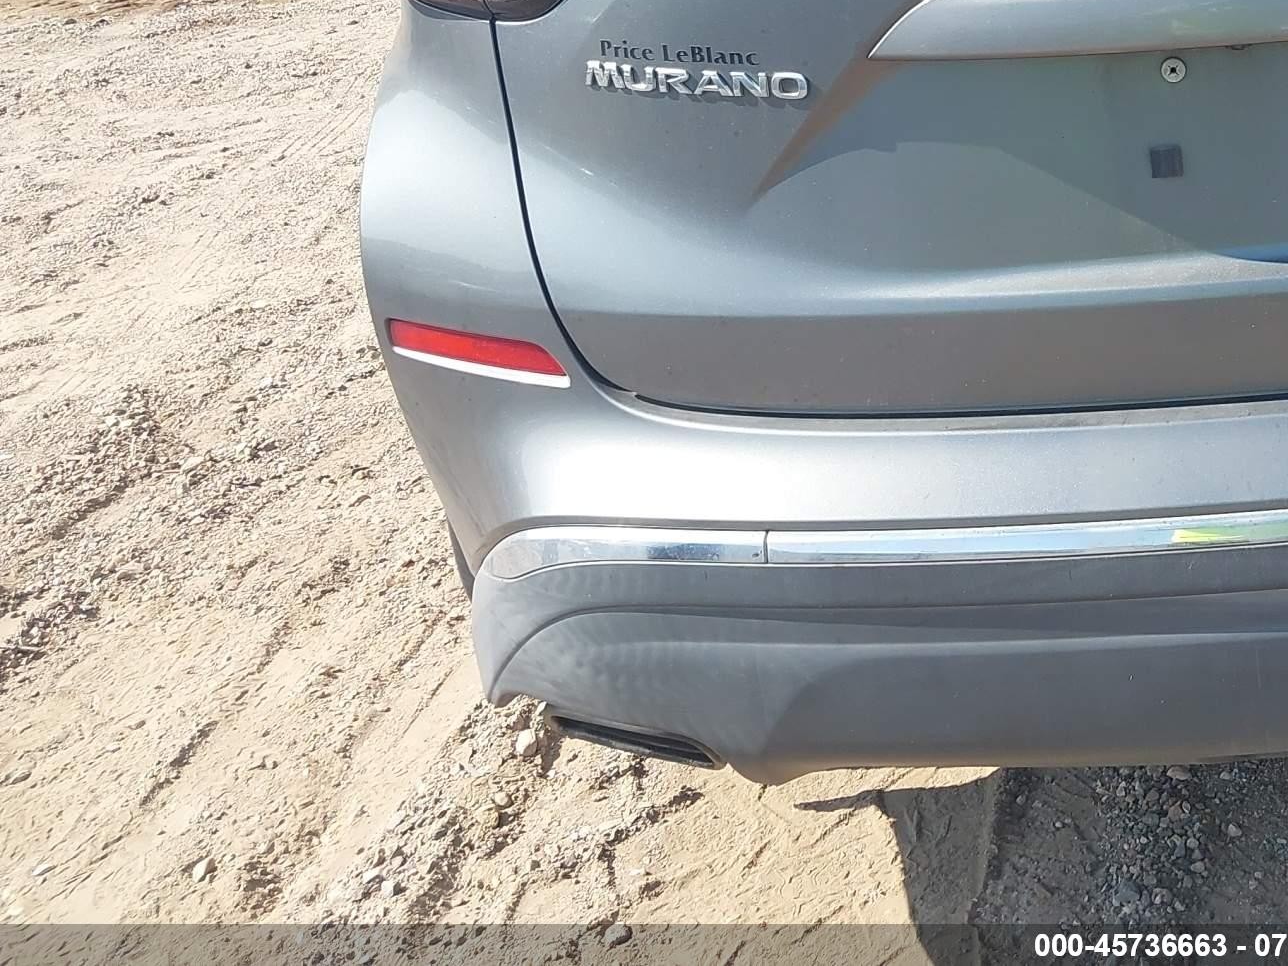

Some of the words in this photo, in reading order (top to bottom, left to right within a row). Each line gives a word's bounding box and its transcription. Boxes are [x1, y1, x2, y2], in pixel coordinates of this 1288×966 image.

[600, 40, 655, 61] Price
[662, 44, 761, 66] LeBlanc
[585, 59, 808, 100] MURANO
